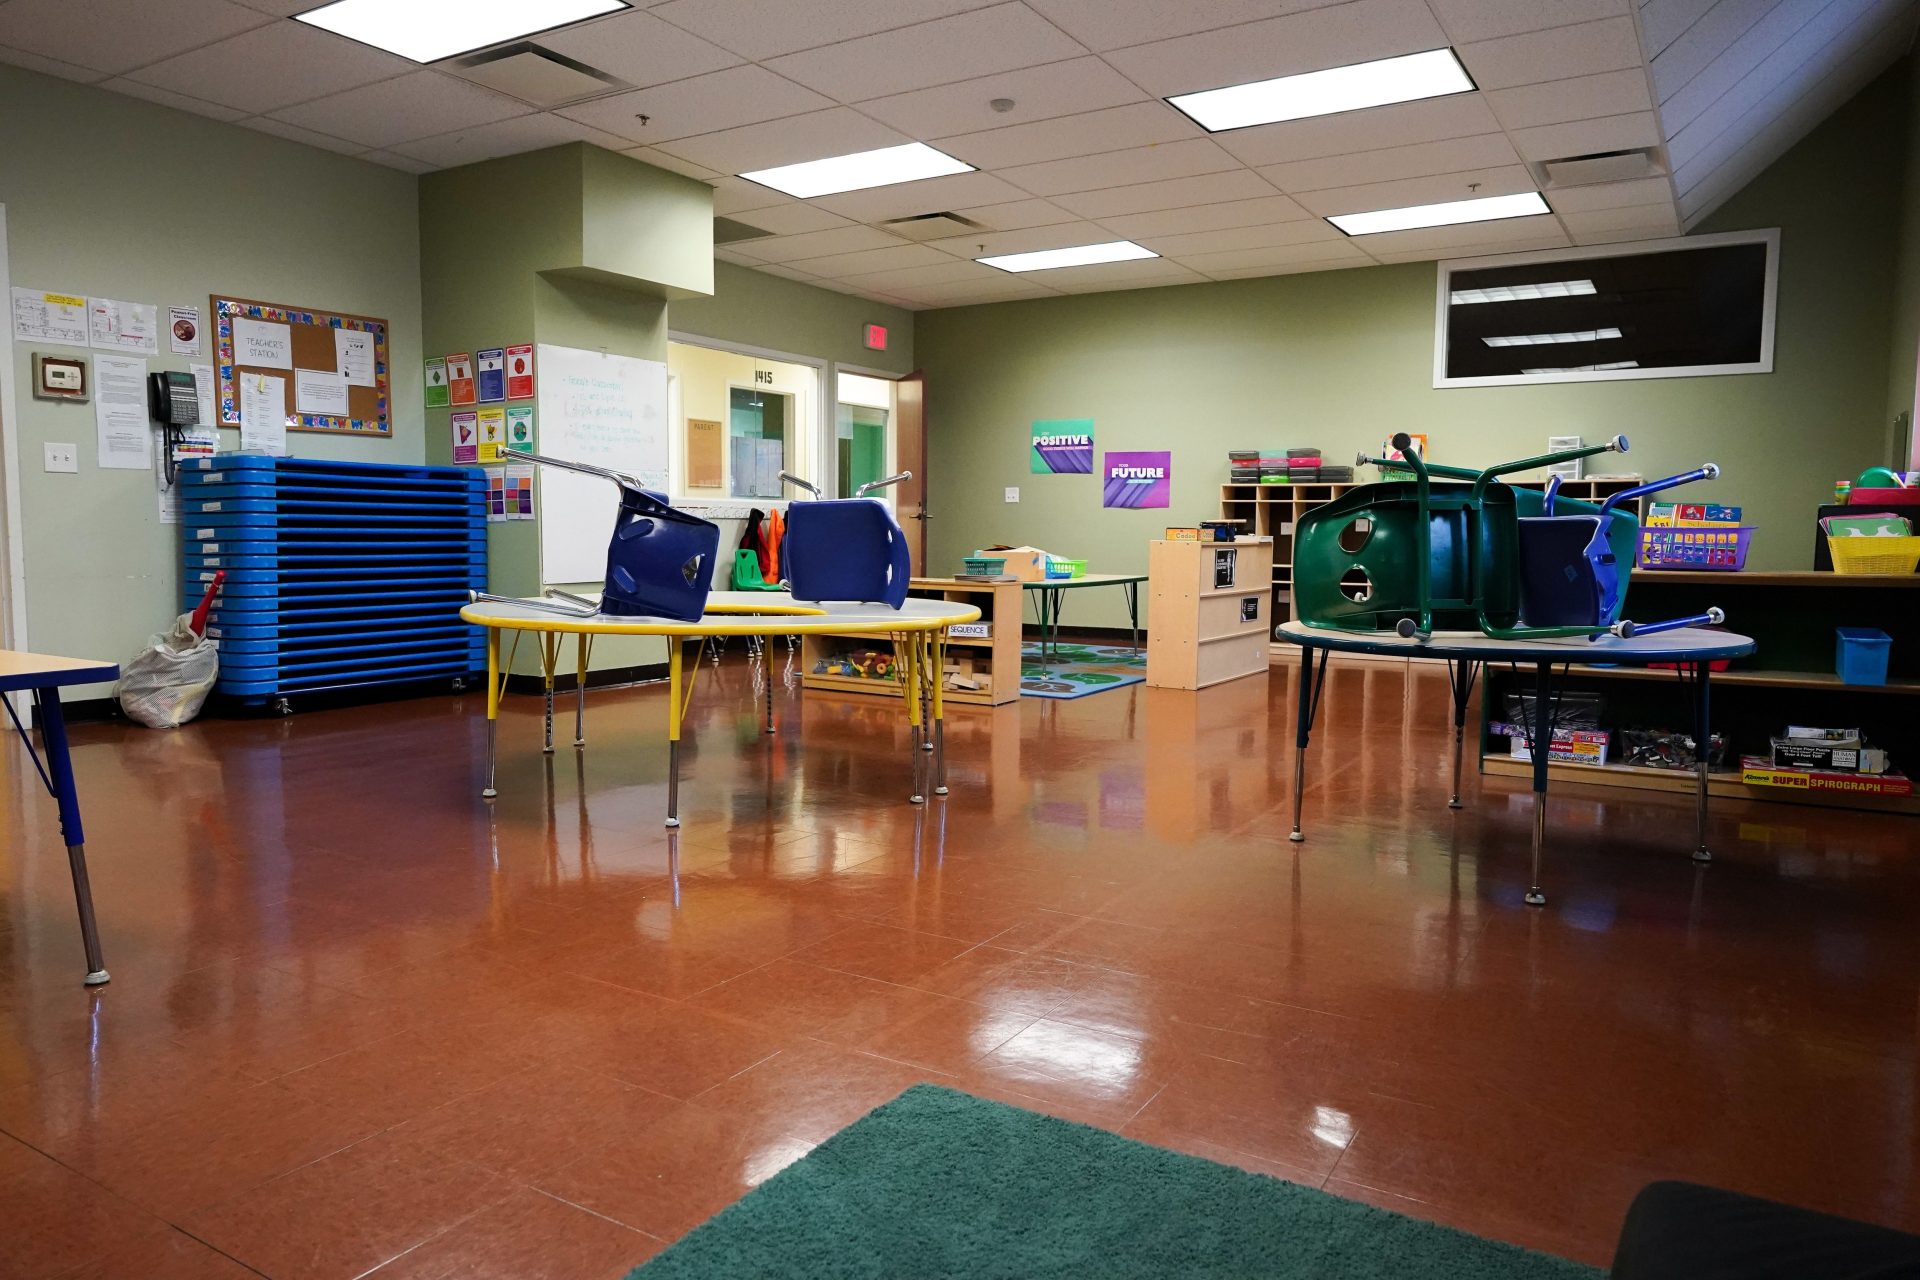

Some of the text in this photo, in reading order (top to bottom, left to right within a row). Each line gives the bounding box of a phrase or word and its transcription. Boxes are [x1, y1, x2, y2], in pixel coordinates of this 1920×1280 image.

[244, 337, 284, 349] TEACHER'S
[870, 327, 886, 349] EXIT
[249, 349, 279, 359] STATION
[755, 370, 773, 384] 1415
[694, 423, 714, 431] PARENT
[1033, 435, 1088, 446] POSITIVE
[1112, 468, 1164, 478] FUTURE
[951, 626, 984, 634] SEQUENCE
[1772, 776, 1808, 787] SUPER
[1811, 778, 1881, 792] SPIROGRAPH
